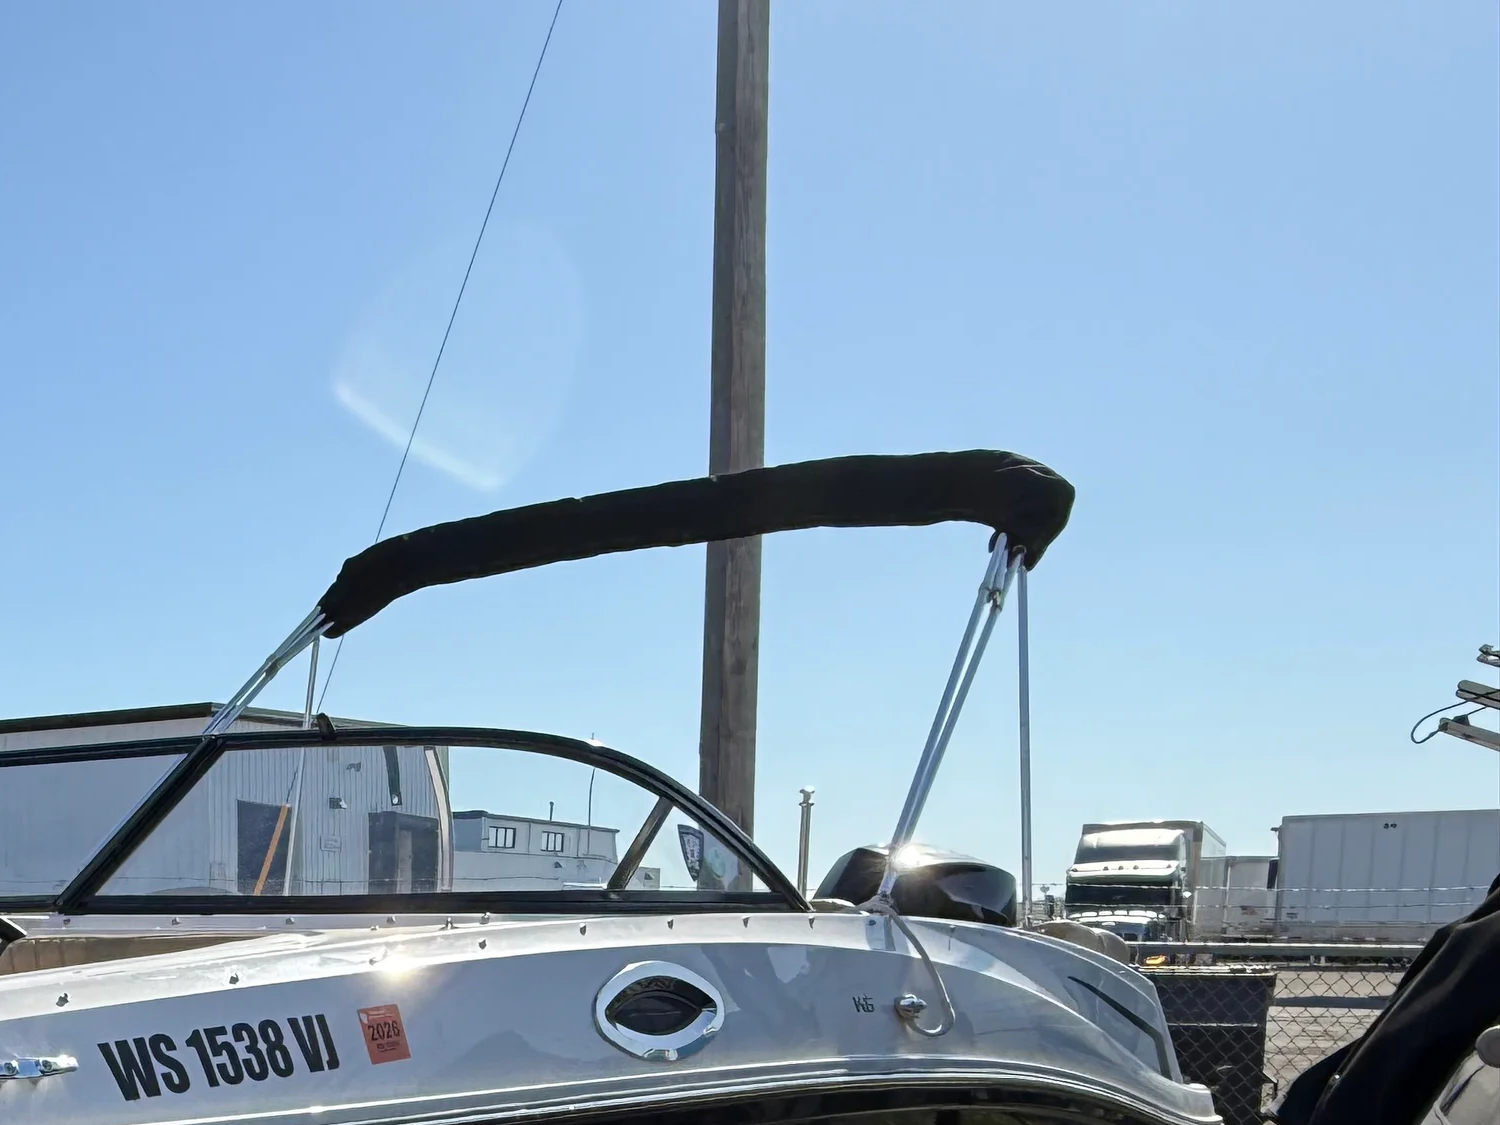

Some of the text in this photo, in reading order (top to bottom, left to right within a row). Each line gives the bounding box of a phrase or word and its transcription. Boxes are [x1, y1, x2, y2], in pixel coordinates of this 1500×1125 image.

[97, 1013, 340, 1101] WS 1538 VJ
[367, 1020, 401, 1041] 2026
